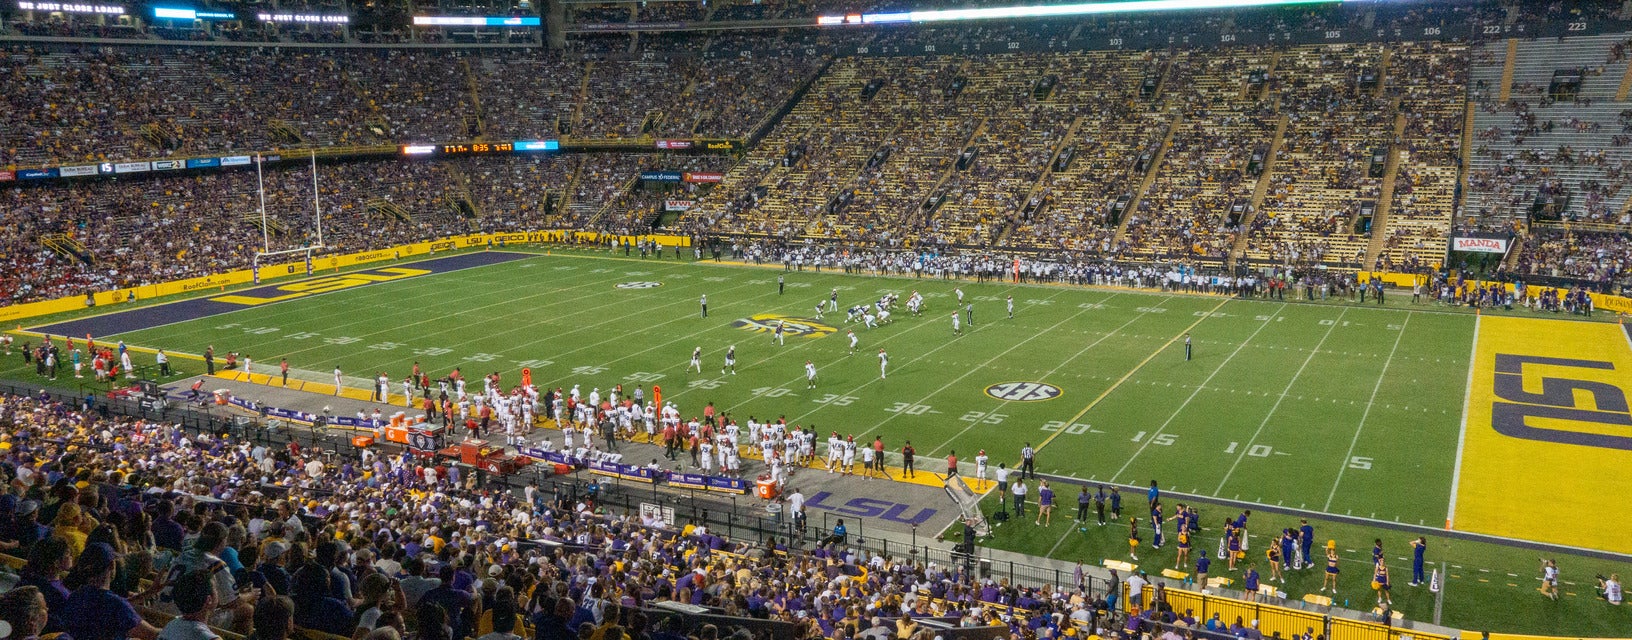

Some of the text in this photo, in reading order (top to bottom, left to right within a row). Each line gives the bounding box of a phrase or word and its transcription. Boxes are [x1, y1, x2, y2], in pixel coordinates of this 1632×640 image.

[1568, 22, 1586, 31] 223
[472, 144, 489, 152] 8:35
[102, 163, 112, 172] 15
[495, 234, 524, 242] GEICO
[432, 241, 456, 250] GEICO
[1458, 239, 1500, 249] MANDA
[208, 268, 433, 306] LSU
[572, 366, 609, 375] 45
[623, 372, 667, 382] 50
[688, 379, 728, 389] 45
[752, 387, 792, 397] 40
[989, 382, 1058, 401] SEC
[812, 394, 860, 406] 35
[1492, 353, 1632, 450] LSU
[884, 402, 932, 415] 30
[959, 411, 1009, 424] 25
[1040, 420, 1091, 435] 20
[388, 430, 395, 439] G
[1131, 431, 1179, 446] 15
[1224, 442, 1273, 458] 10
[1349, 456, 1374, 470] 5
[760, 486, 767, 494] G
[804, 491, 938, 524] LSU
